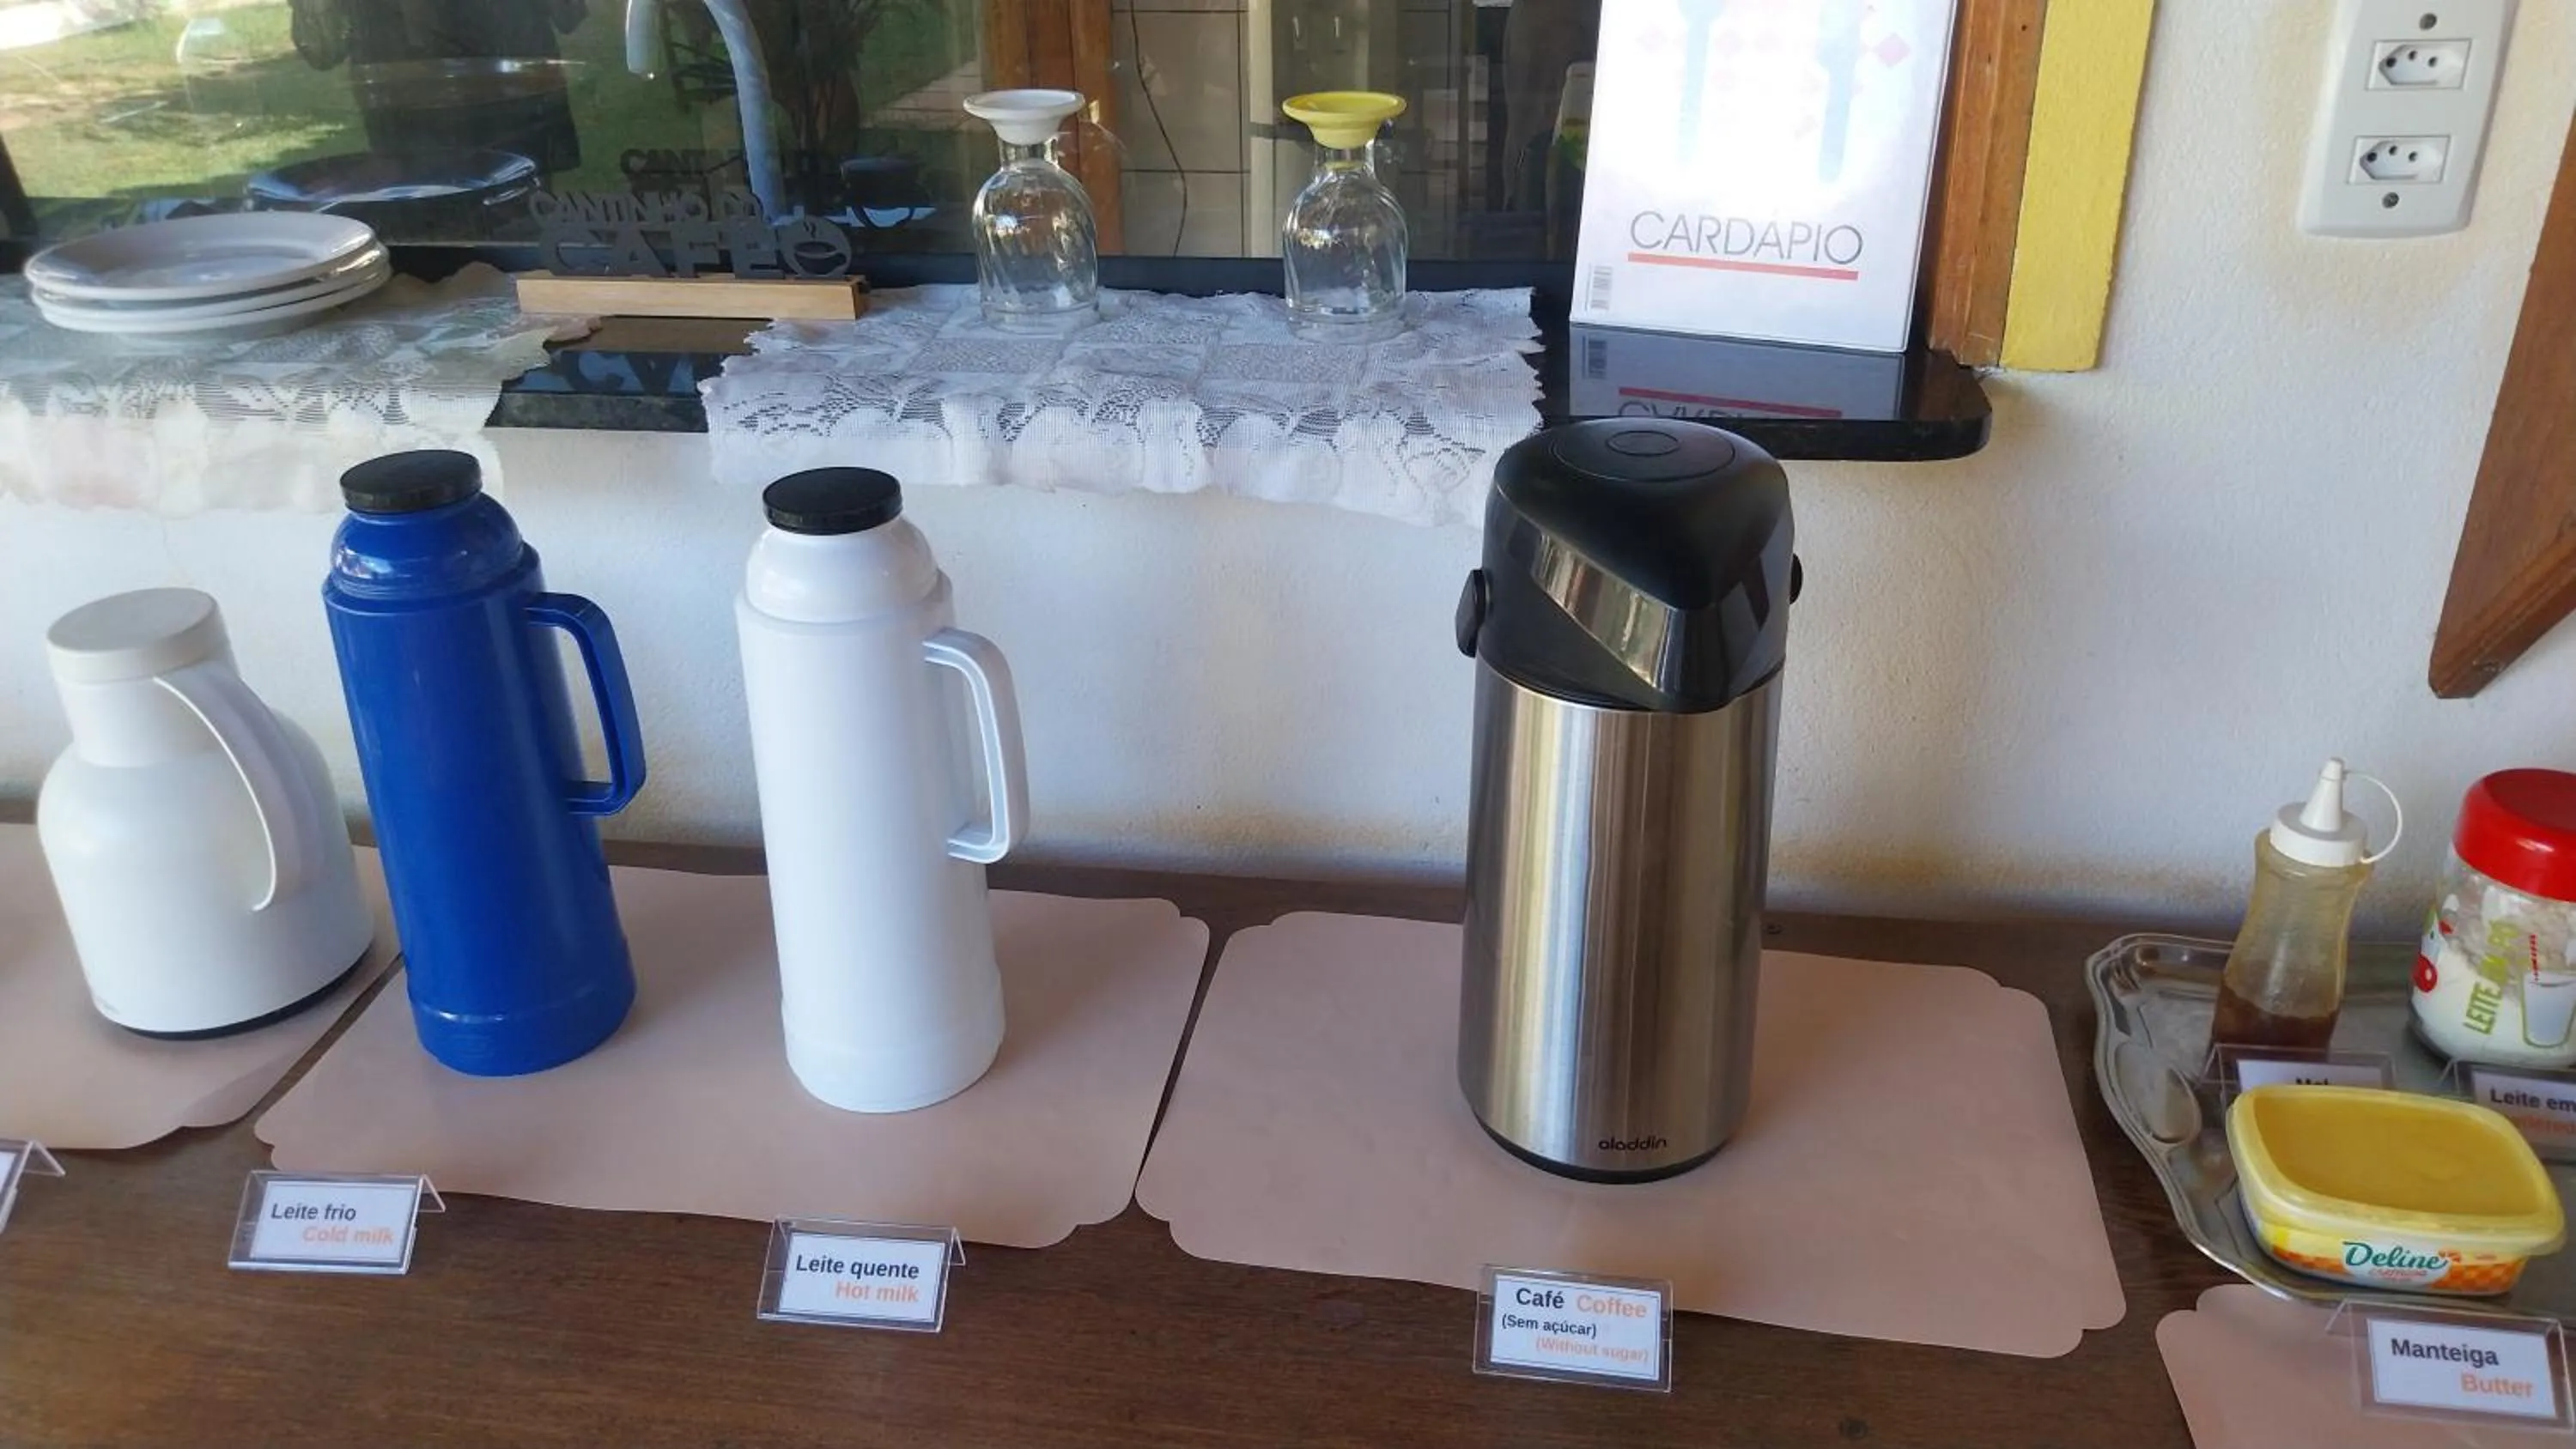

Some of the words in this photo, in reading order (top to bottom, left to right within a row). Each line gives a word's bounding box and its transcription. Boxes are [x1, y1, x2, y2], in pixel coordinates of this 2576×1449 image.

[2463, 981, 2503, 1035] LEITE
[2490, 1087, 2540, 1108] Leite
[1598, 1136, 1667, 1151] aladdin
[271, 1203, 319, 1220] Leite
[324, 1203, 357, 1221] frio
[303, 1225, 348, 1242] Cold
[354, 1227, 394, 1243] milk
[796, 1254, 845, 1274] Leite
[850, 1261, 920, 1280] quente
[2342, 1241, 2448, 1270] Deline
[835, 1281, 872, 1300] Hot
[876, 1282, 919, 1302] milk
[1516, 1288, 1564, 1309] Café
[1576, 1294, 1648, 1318] Coffee
[1502, 1313, 1539, 1330] (Sem
[1543, 1319, 1596, 1339] açúcar)
[1535, 1337, 1598, 1355] (Without
[1601, 1345, 1649, 1363] sugar)
[2391, 1337, 2499, 1367] Manteiga
[2461, 1373, 2533, 1397] Butter
